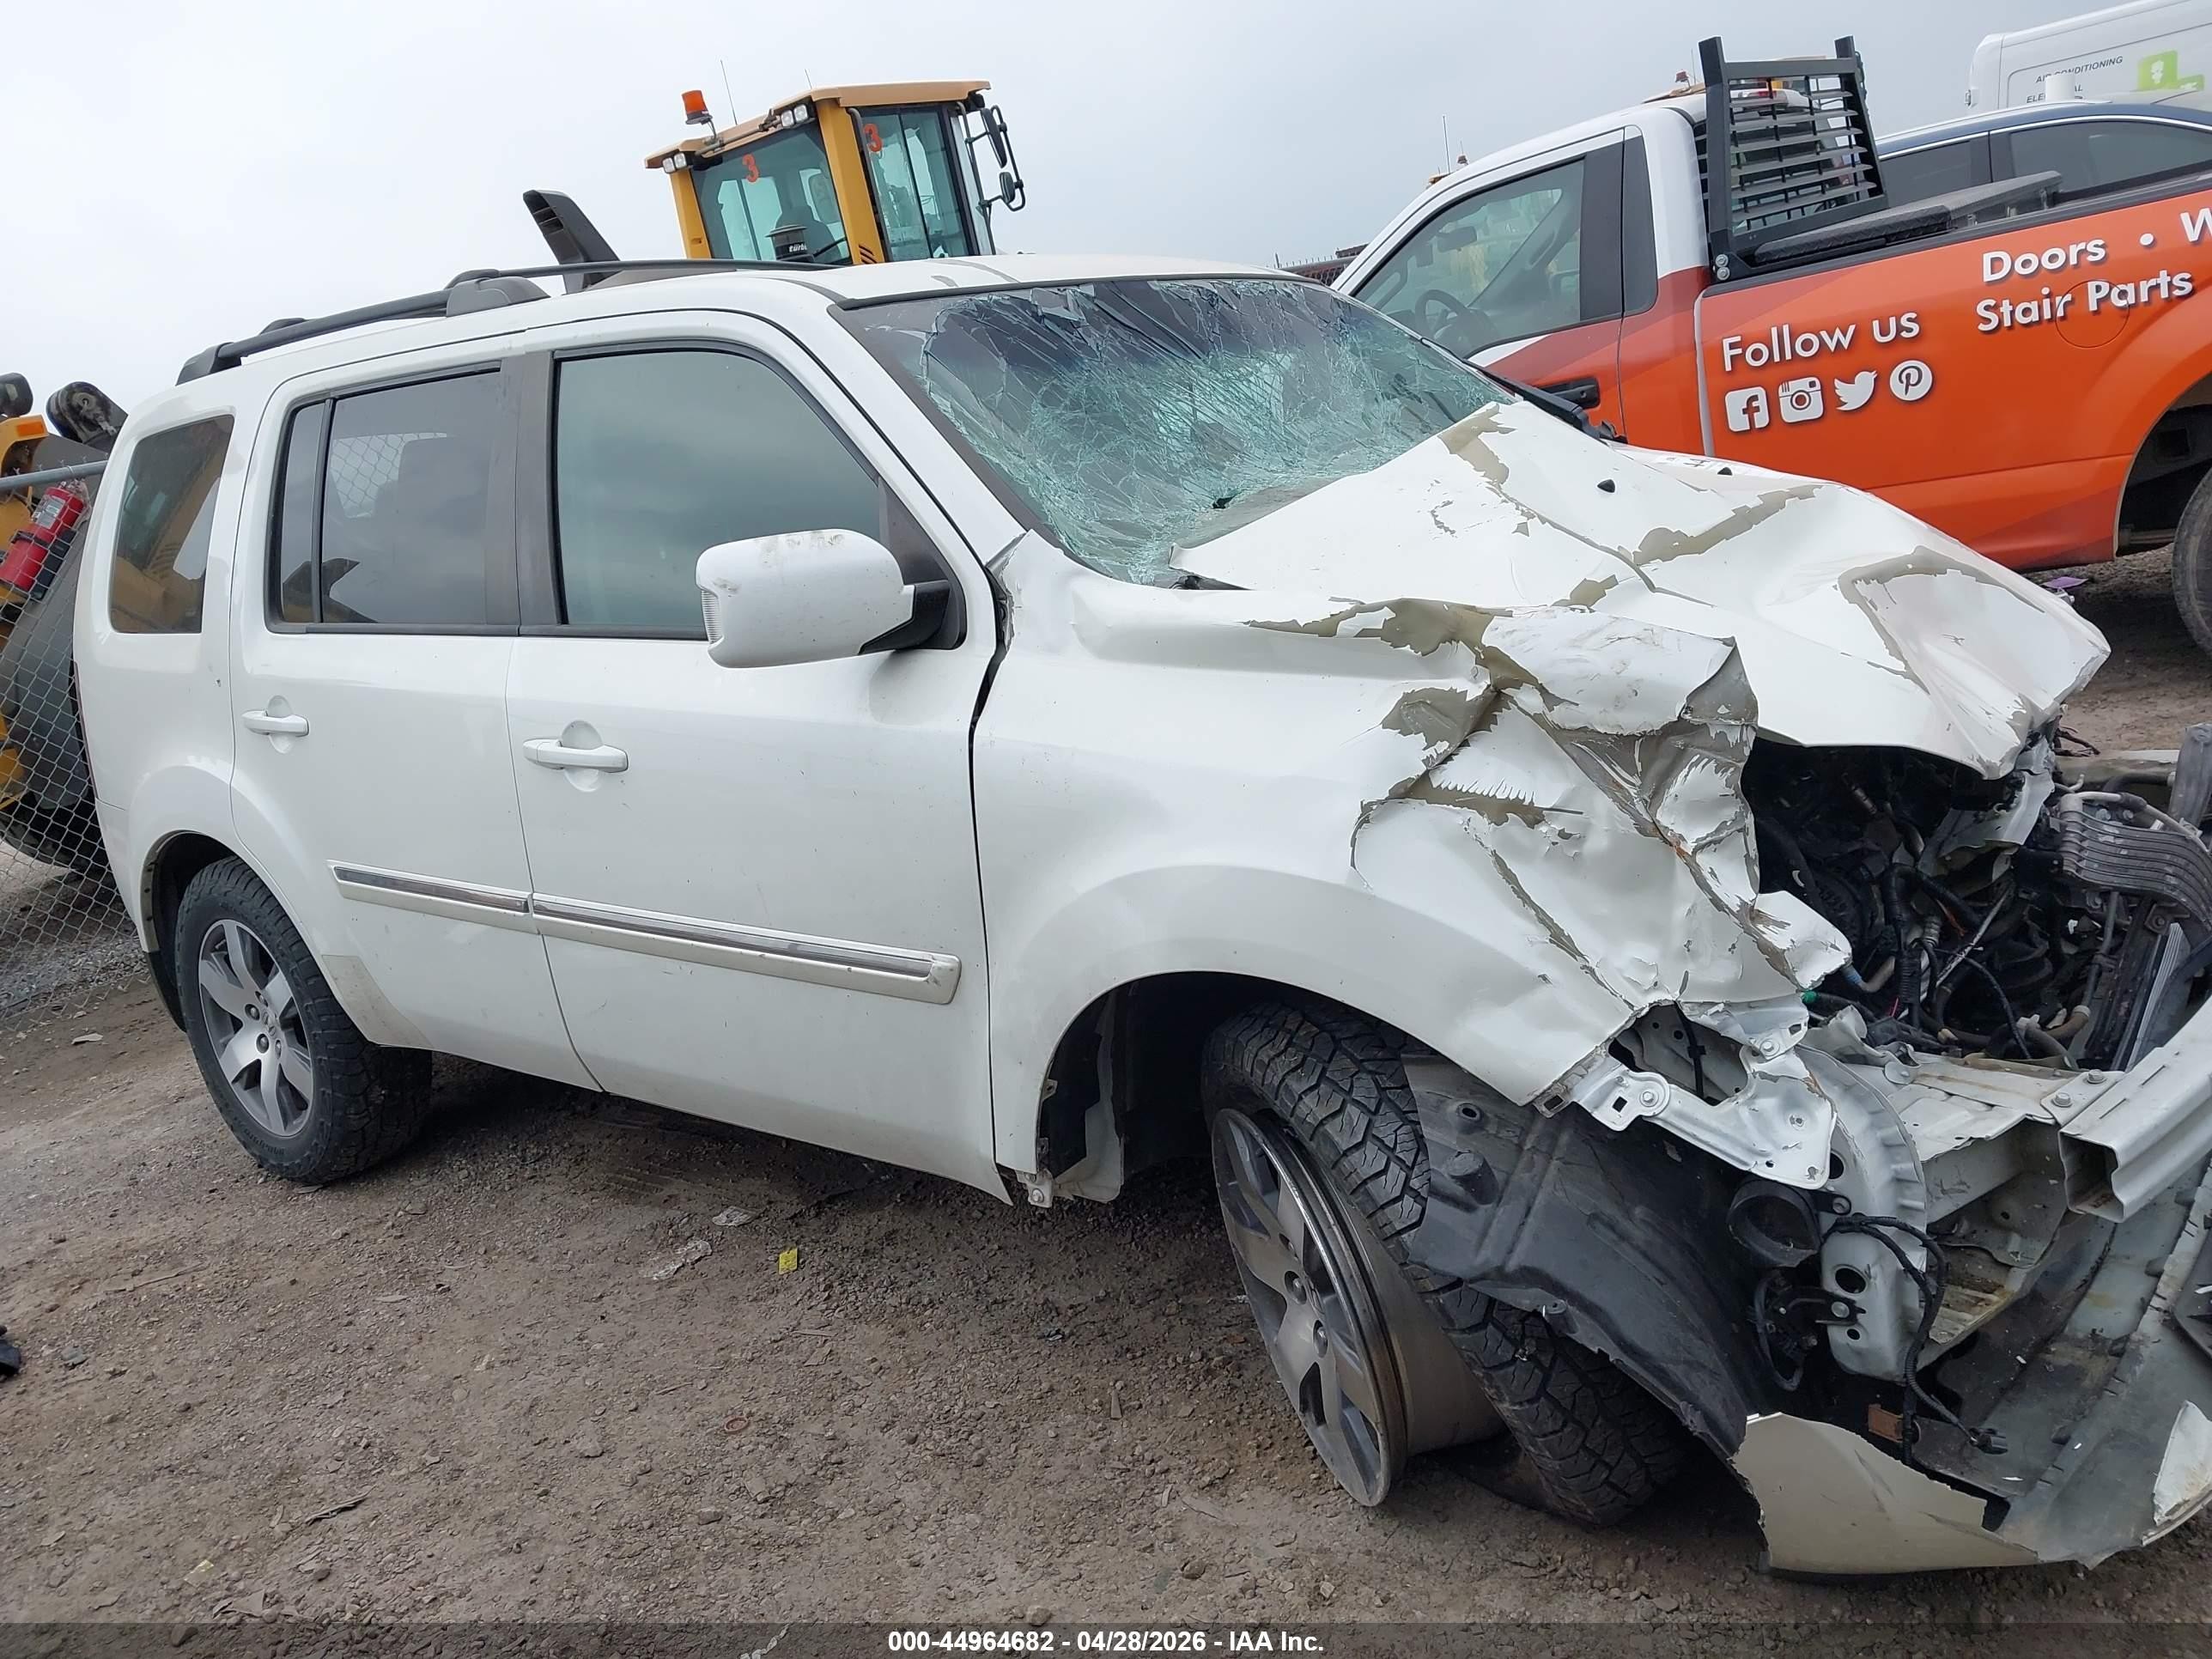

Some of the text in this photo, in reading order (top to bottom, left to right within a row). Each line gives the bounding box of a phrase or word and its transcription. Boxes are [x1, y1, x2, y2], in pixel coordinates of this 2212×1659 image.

[2036, 74, 2051, 83] AI
[863, 124, 883, 152] 3
[742, 154, 759, 182] 3
[1983, 240, 2106, 282] Doors
[1977, 270, 2193, 331] Stair Parts
[1723, 312, 1920, 372] Follow us
